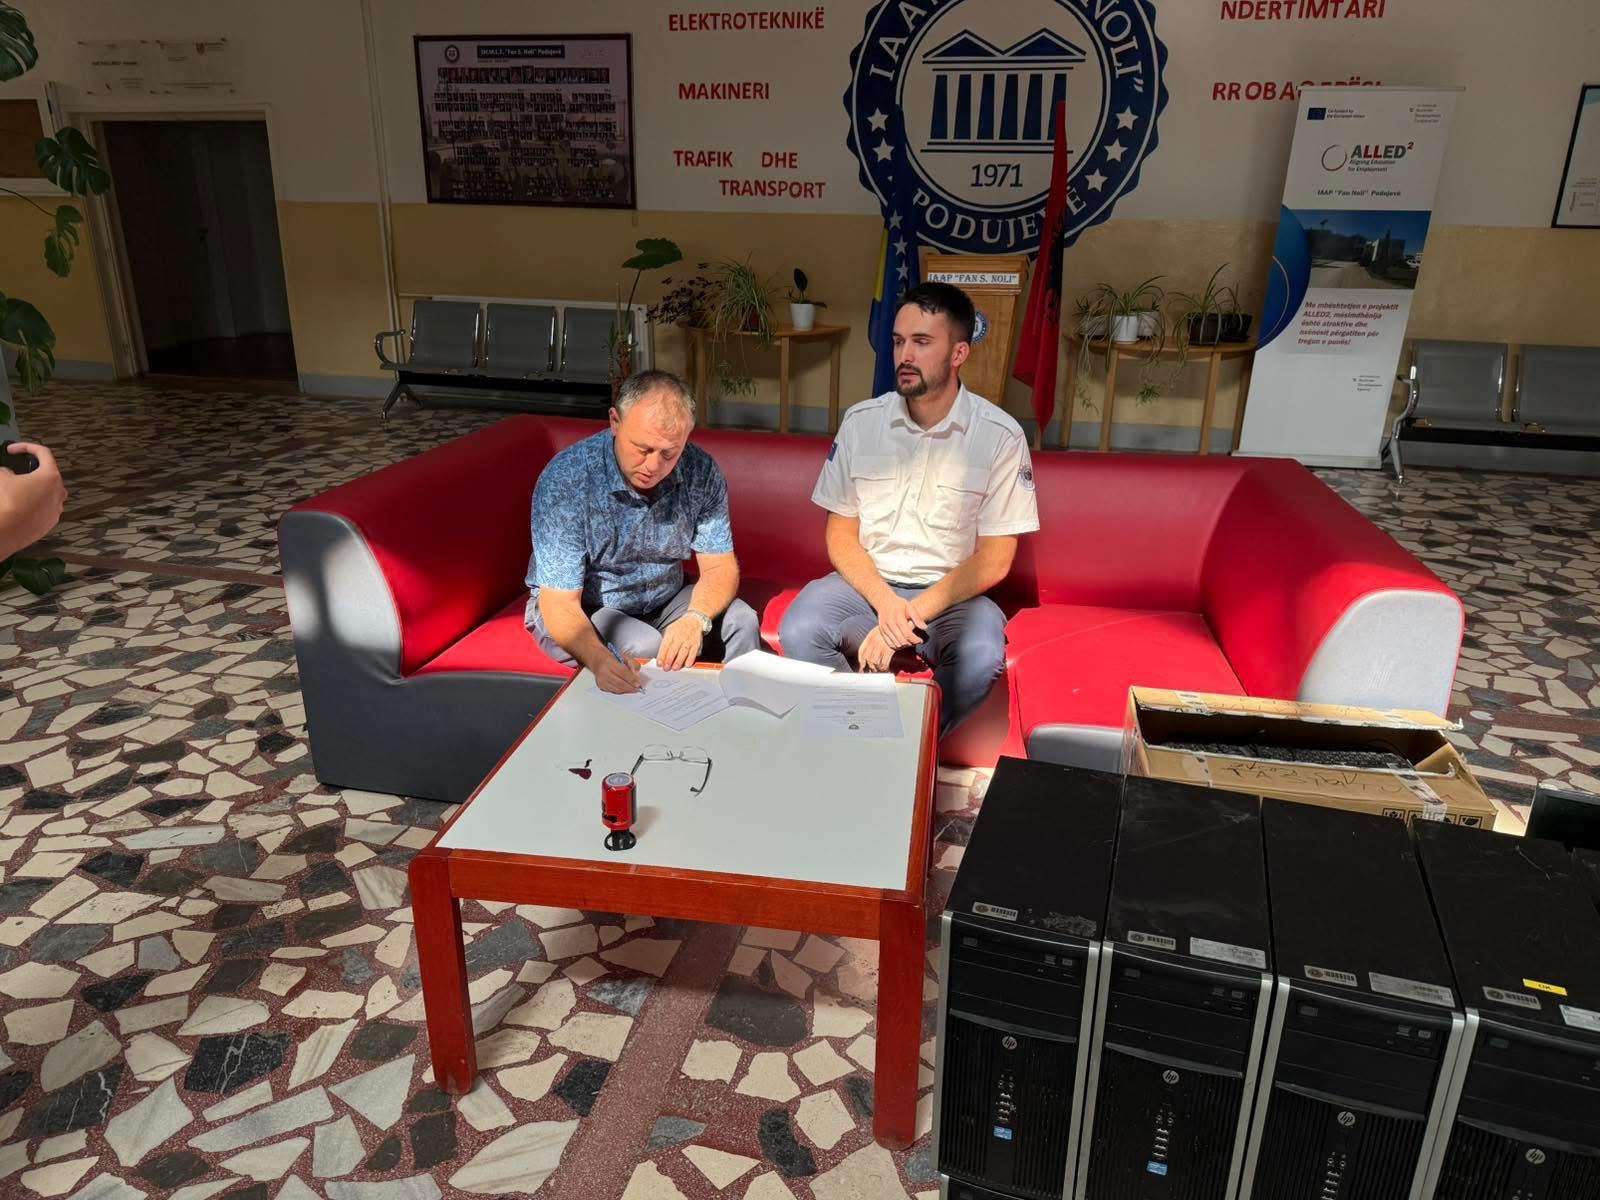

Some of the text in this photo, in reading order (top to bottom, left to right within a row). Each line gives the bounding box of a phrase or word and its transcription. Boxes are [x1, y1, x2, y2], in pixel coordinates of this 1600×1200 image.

[668, 7, 825, 31] ELEKTROTEKNIKË
[868, 0, 938, 82] IAA
[679, 82, 769, 100] MAKINERI
[673, 150, 798, 169] TRAFIK DHE
[970, 164, 1023, 187] 1971
[718, 179, 826, 199] TRANSPORT
[928, 273, 953, 282] IAAP
[979, 274, 988, 283] S.
